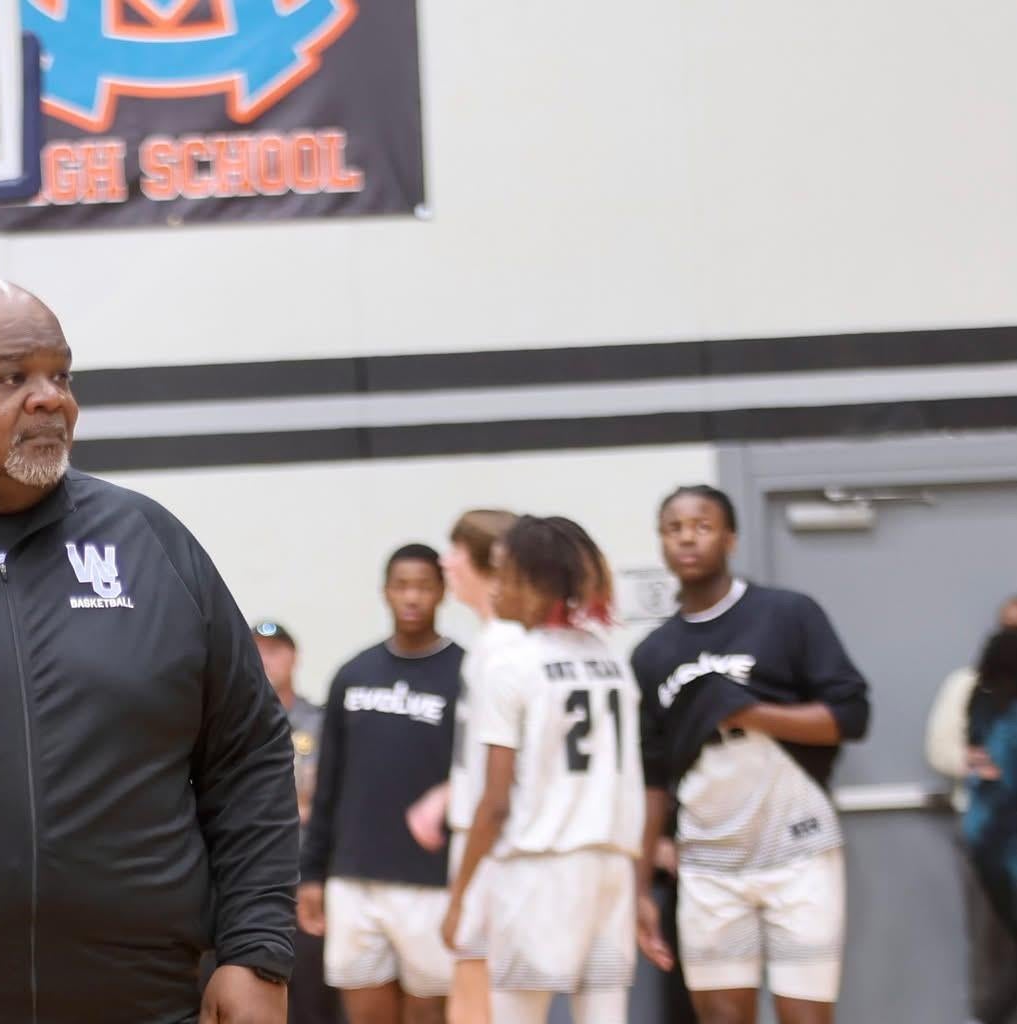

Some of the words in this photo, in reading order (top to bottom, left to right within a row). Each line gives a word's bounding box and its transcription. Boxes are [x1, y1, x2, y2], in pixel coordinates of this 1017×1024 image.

[35, 136, 128, 205] GH
[141, 131, 362, 200] SCHOOL
[69, 597, 134, 608] BASKETBALL
[564, 688, 624, 773] 21
